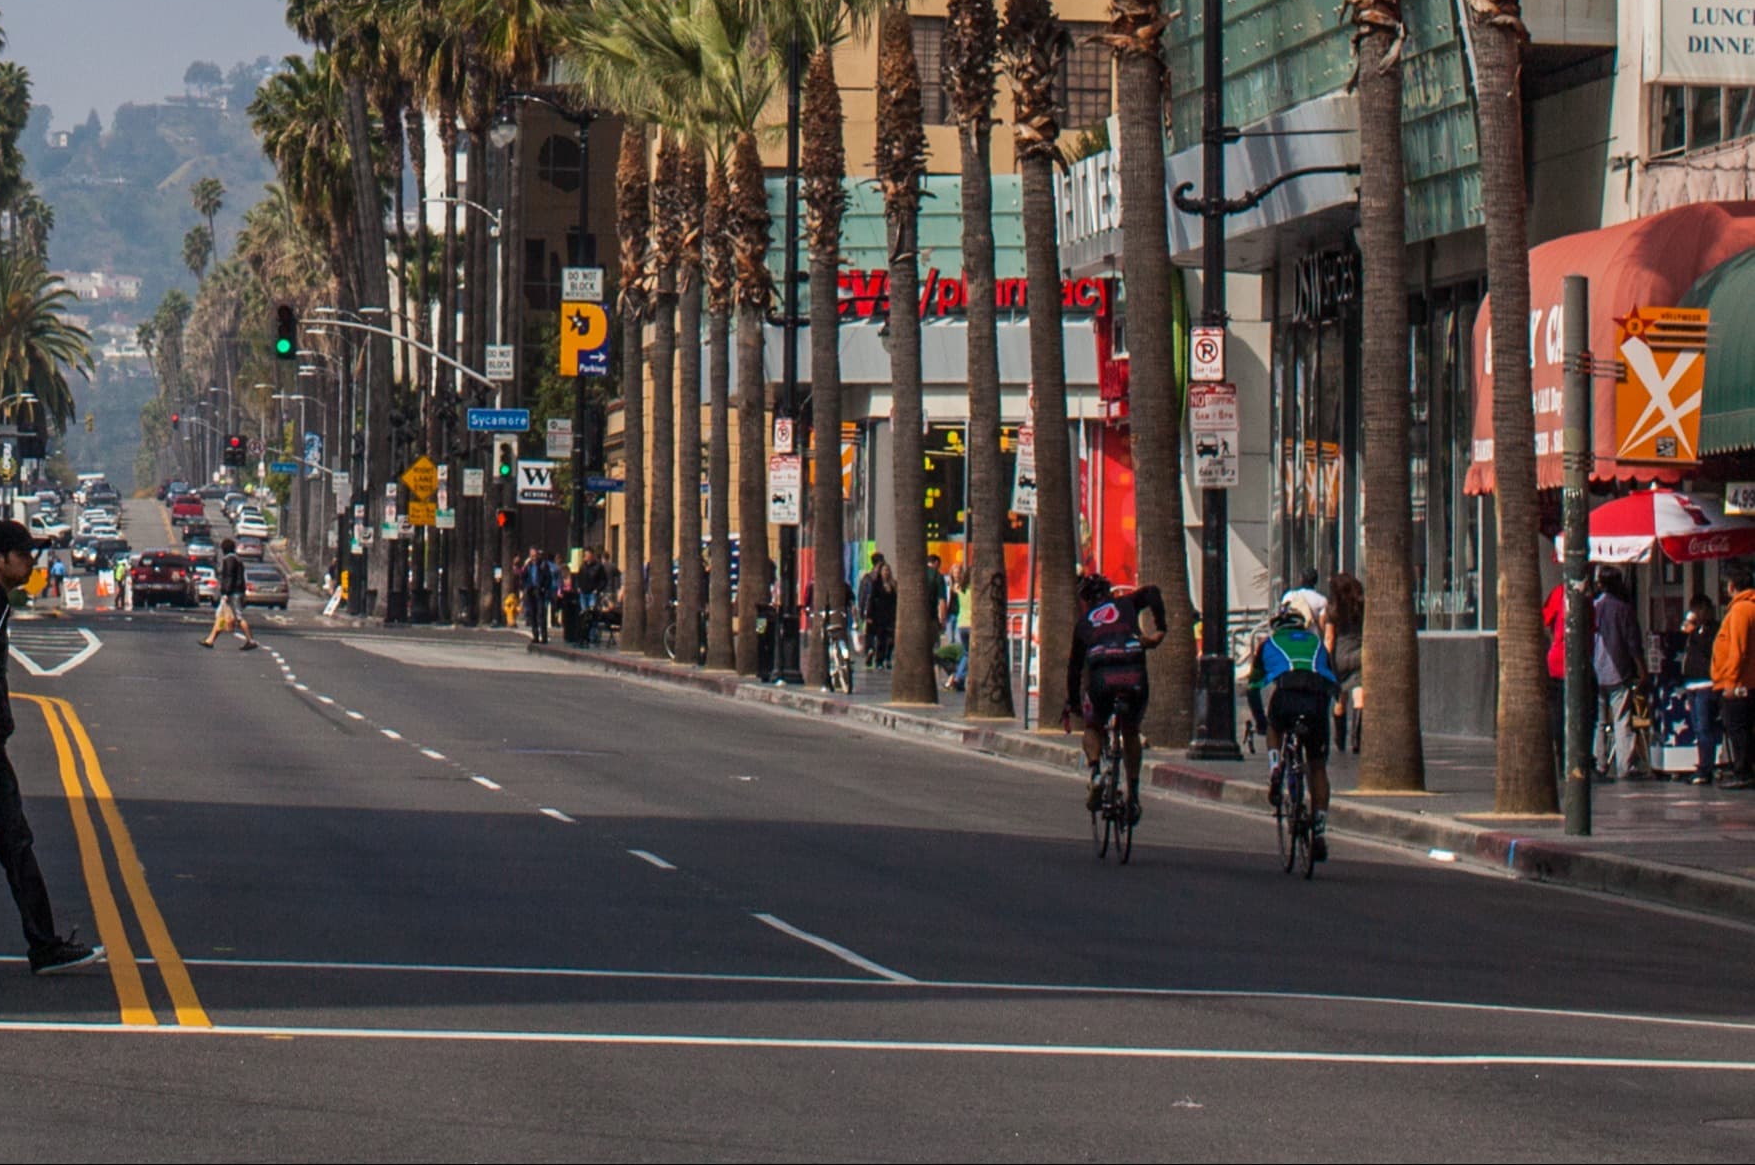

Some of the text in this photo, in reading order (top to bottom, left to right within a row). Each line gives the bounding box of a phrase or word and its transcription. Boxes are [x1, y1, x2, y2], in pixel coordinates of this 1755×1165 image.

[568, 271, 579, 280] DO
[570, 282, 595, 291] BLOCK
[579, 364, 607, 376] Parking
[1191, 394, 1205, 407] NO
[471, 414, 527, 426] Sycamore
[523, 467, 550, 486] W
